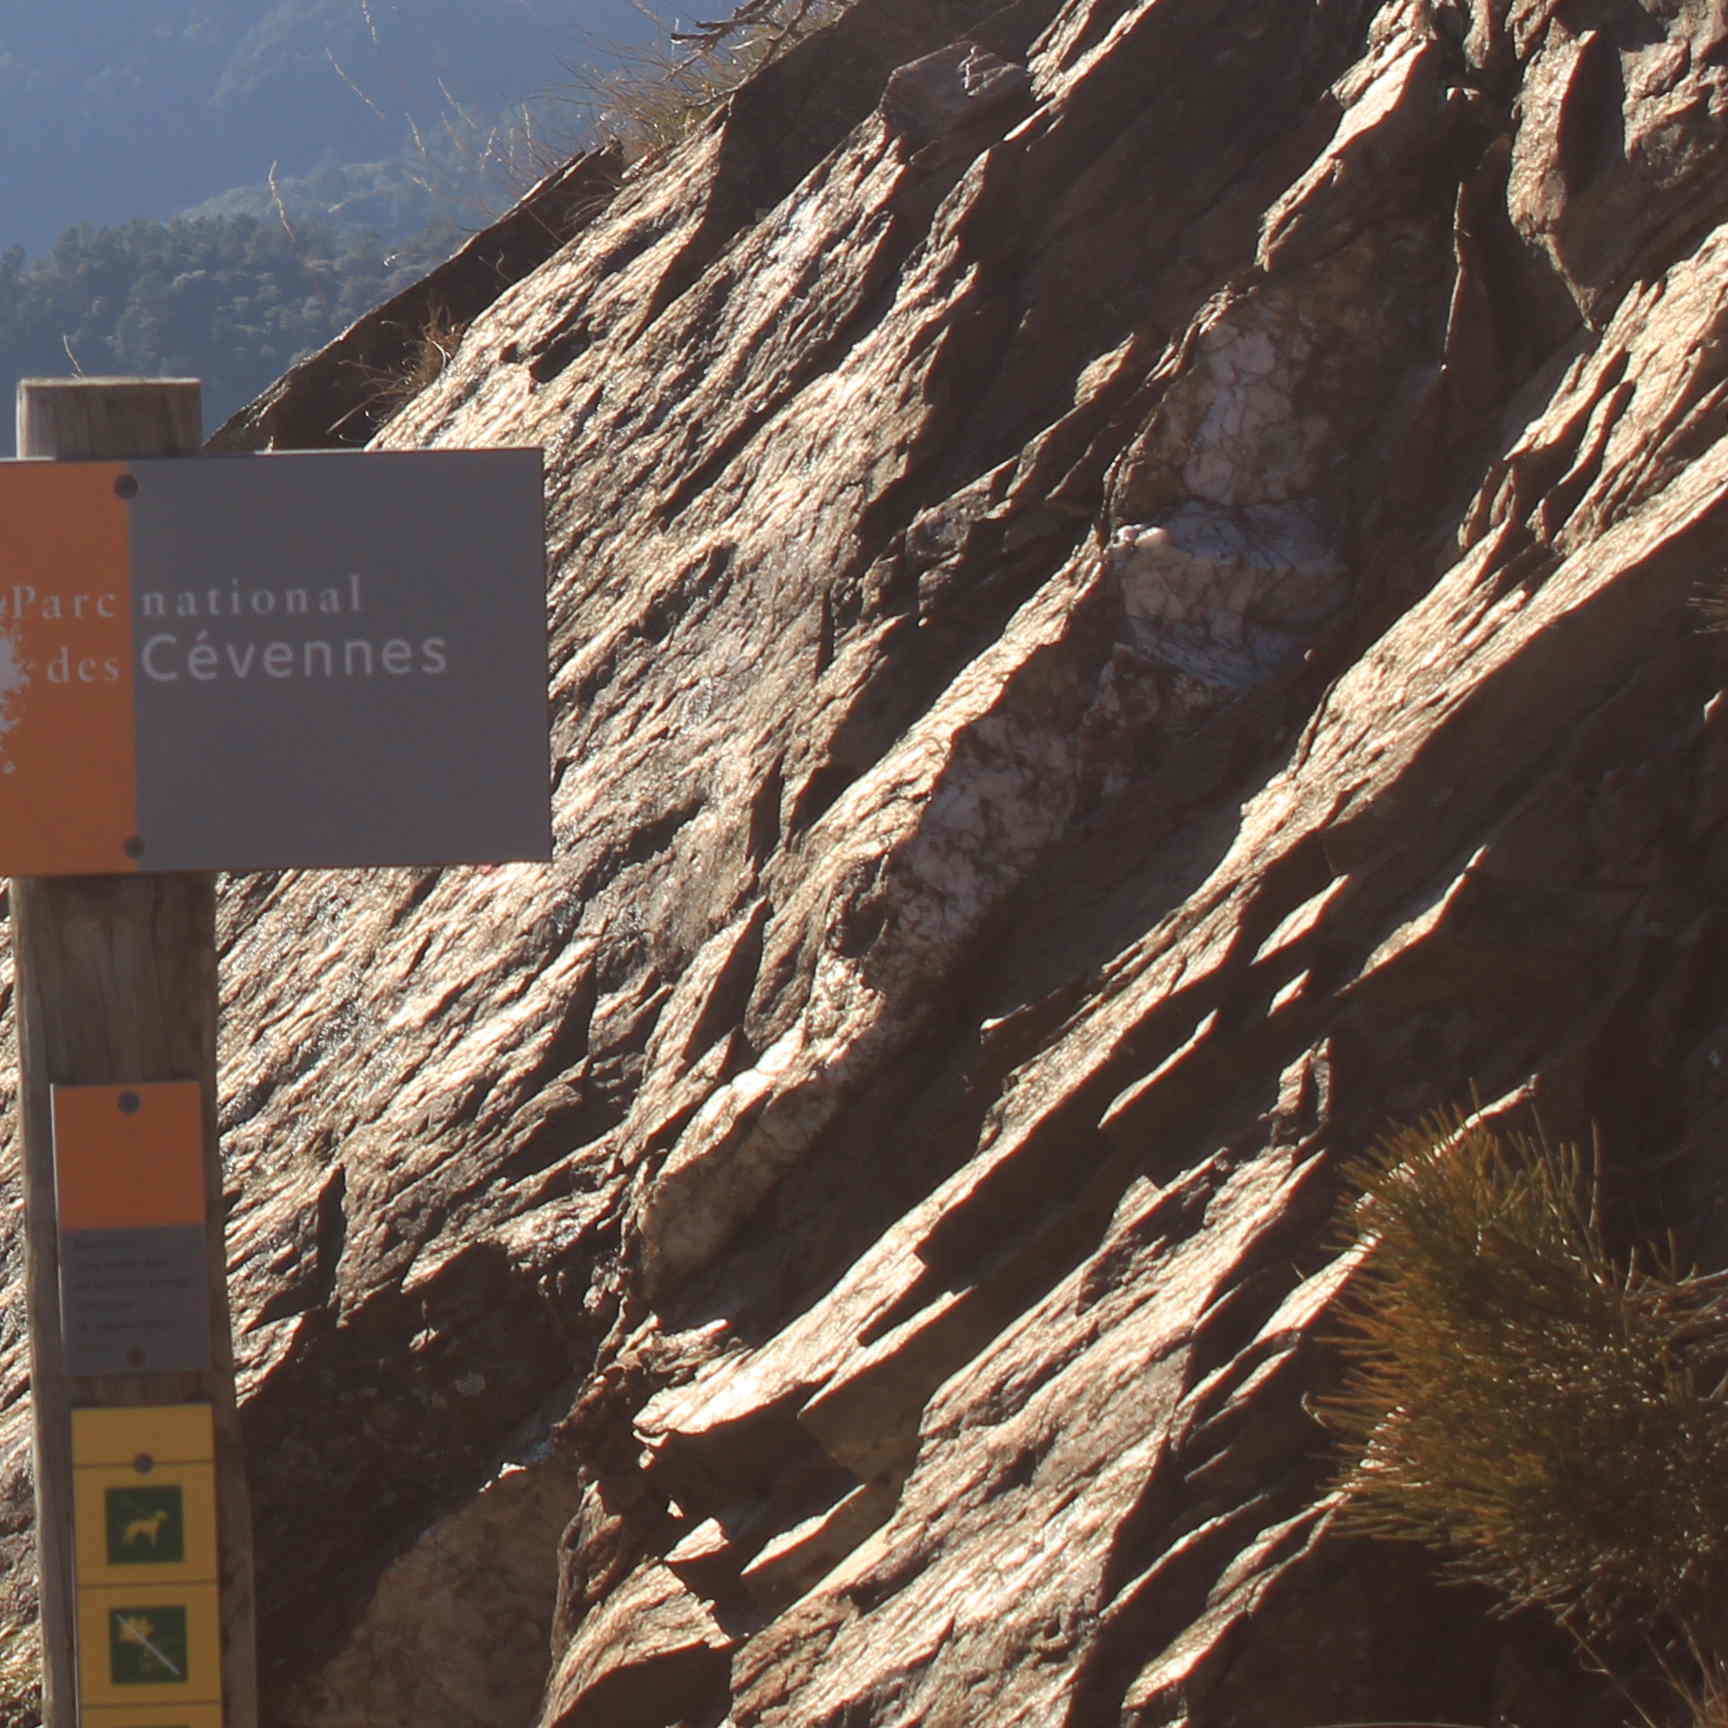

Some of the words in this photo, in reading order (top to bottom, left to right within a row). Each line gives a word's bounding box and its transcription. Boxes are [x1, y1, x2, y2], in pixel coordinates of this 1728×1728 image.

[11, 585, 117, 619] Parc
[142, 574, 363, 617] national
[47, 648, 121, 683] des
[142, 630, 448, 682] Cévennes
